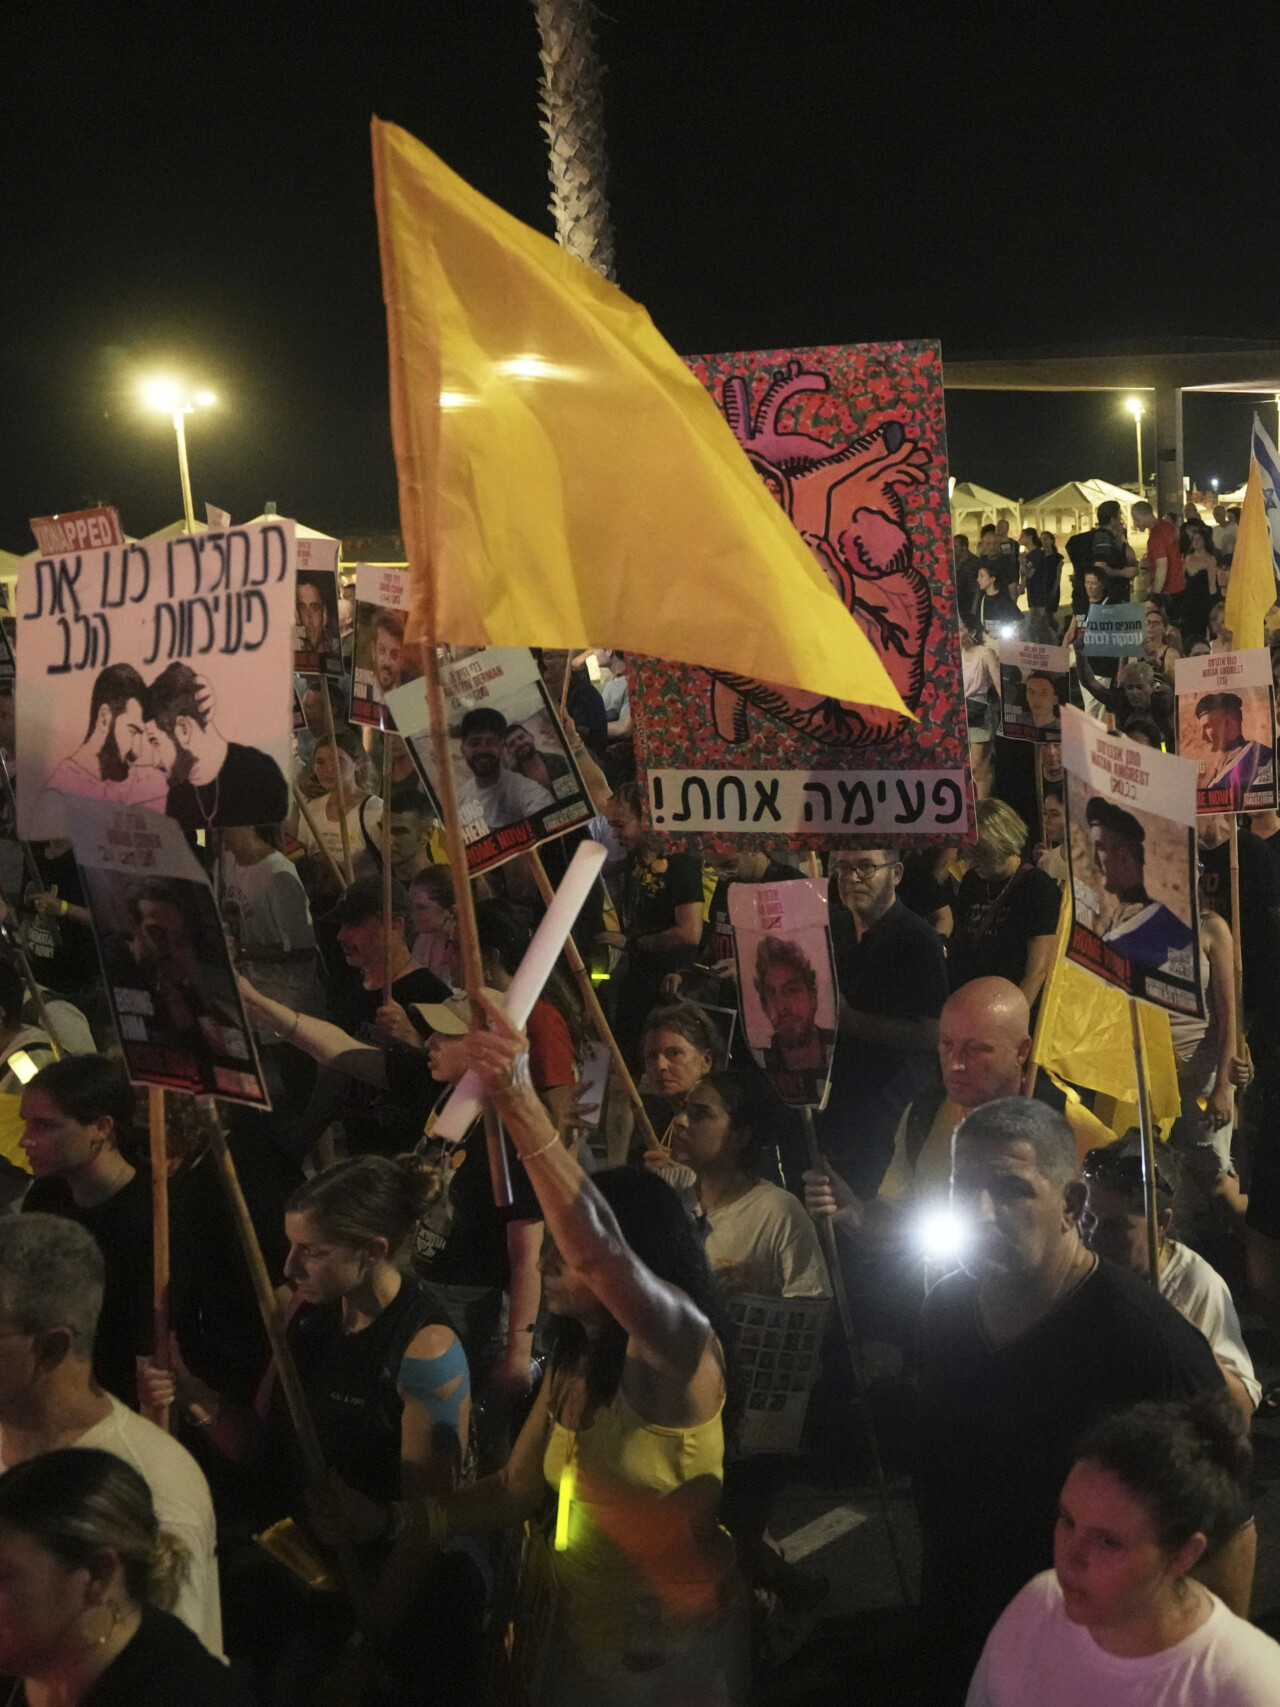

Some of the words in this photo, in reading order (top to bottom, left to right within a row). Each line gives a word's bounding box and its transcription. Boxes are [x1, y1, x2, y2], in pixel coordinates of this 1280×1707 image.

[101, 543, 150, 609] לנו
[166, 525, 287, 598] תחזירו
[24, 556, 82, 620] את
[47, 612, 110, 675] הלב
[143, 590, 268, 664] פעימות
[1112, 632, 1144, 646] עסקה
[471, 665, 505, 687] BERMAN
[1113, 762, 1150, 787] ANGREST
[1211, 786, 1233, 805] NOW!
[653, 776, 782, 824] אחת!
[803, 778, 963, 825] פעימה
[497, 820, 535, 851] NOW!
